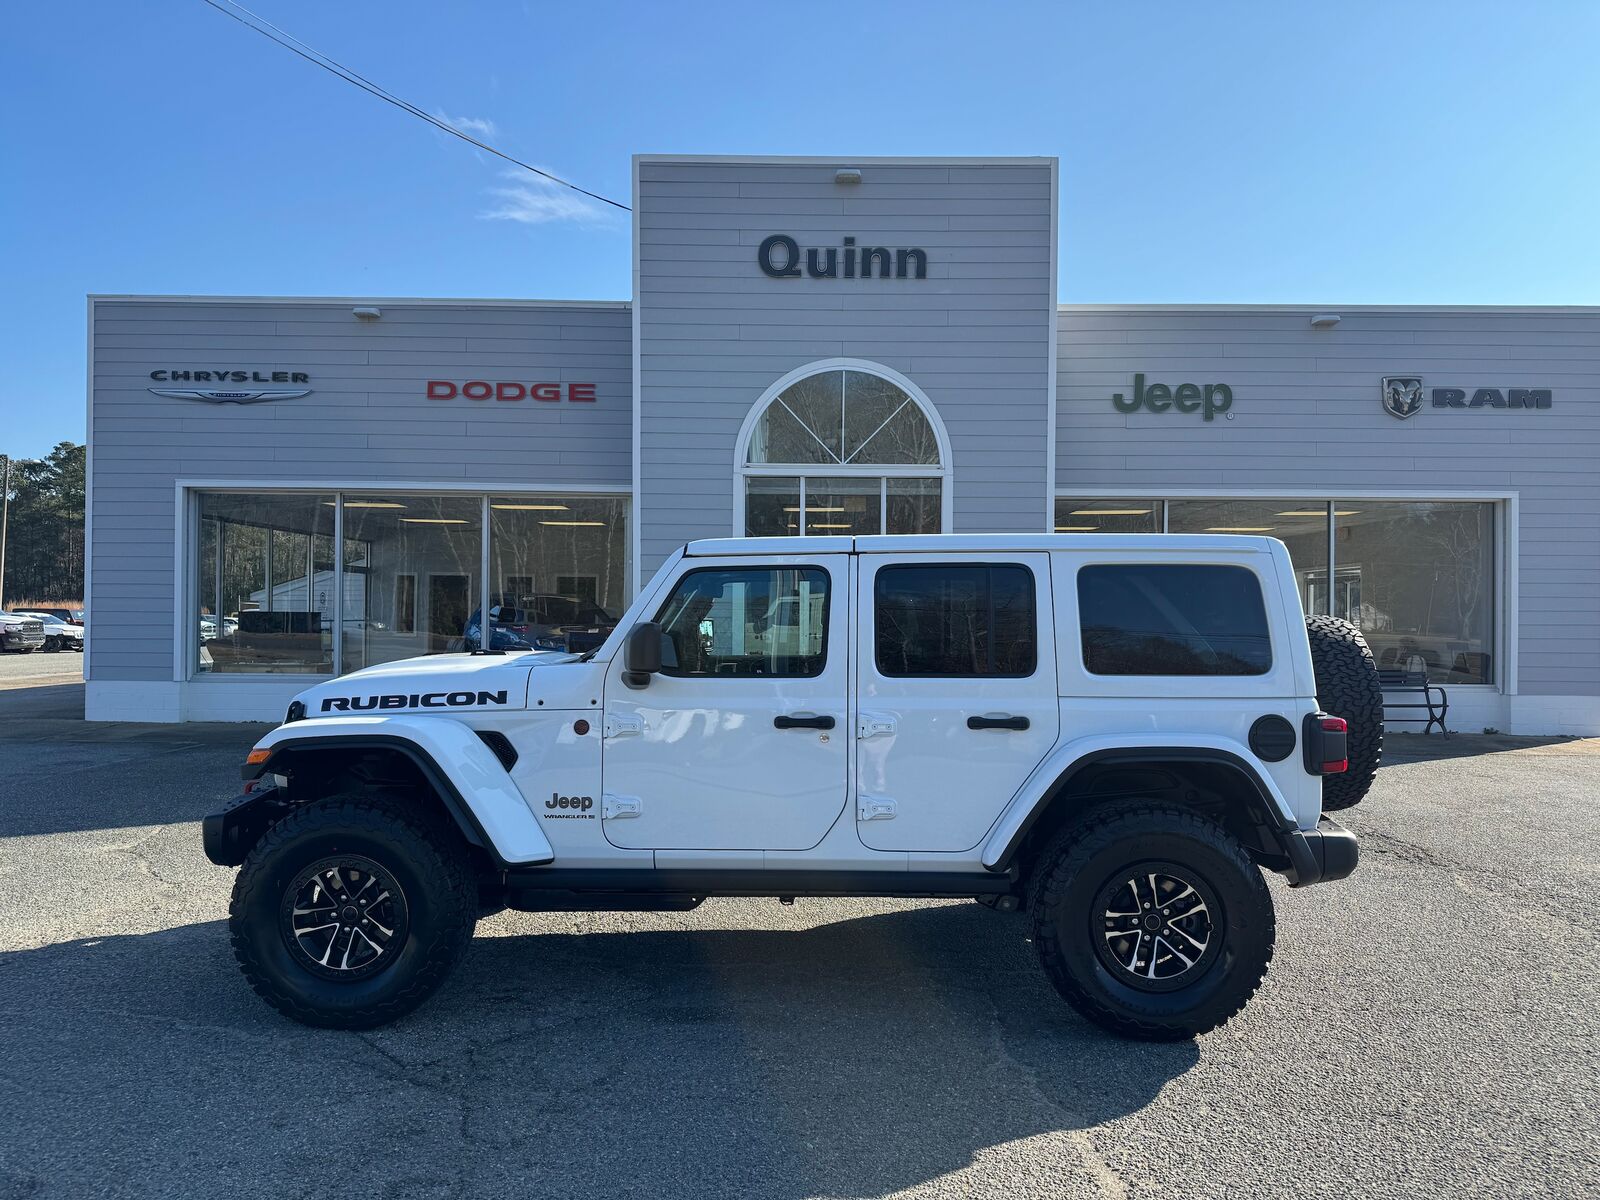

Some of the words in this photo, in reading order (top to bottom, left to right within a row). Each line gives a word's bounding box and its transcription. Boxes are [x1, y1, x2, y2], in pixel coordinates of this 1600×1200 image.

[758, 234, 927, 279] Quinn
[150, 370, 309, 384] CHRYSLER
[427, 381, 596, 402] DODGE
[1432, 388, 1552, 409] RAM
[321, 690, 507, 712] RUBICON
[545, 792, 593, 811] Jeep
